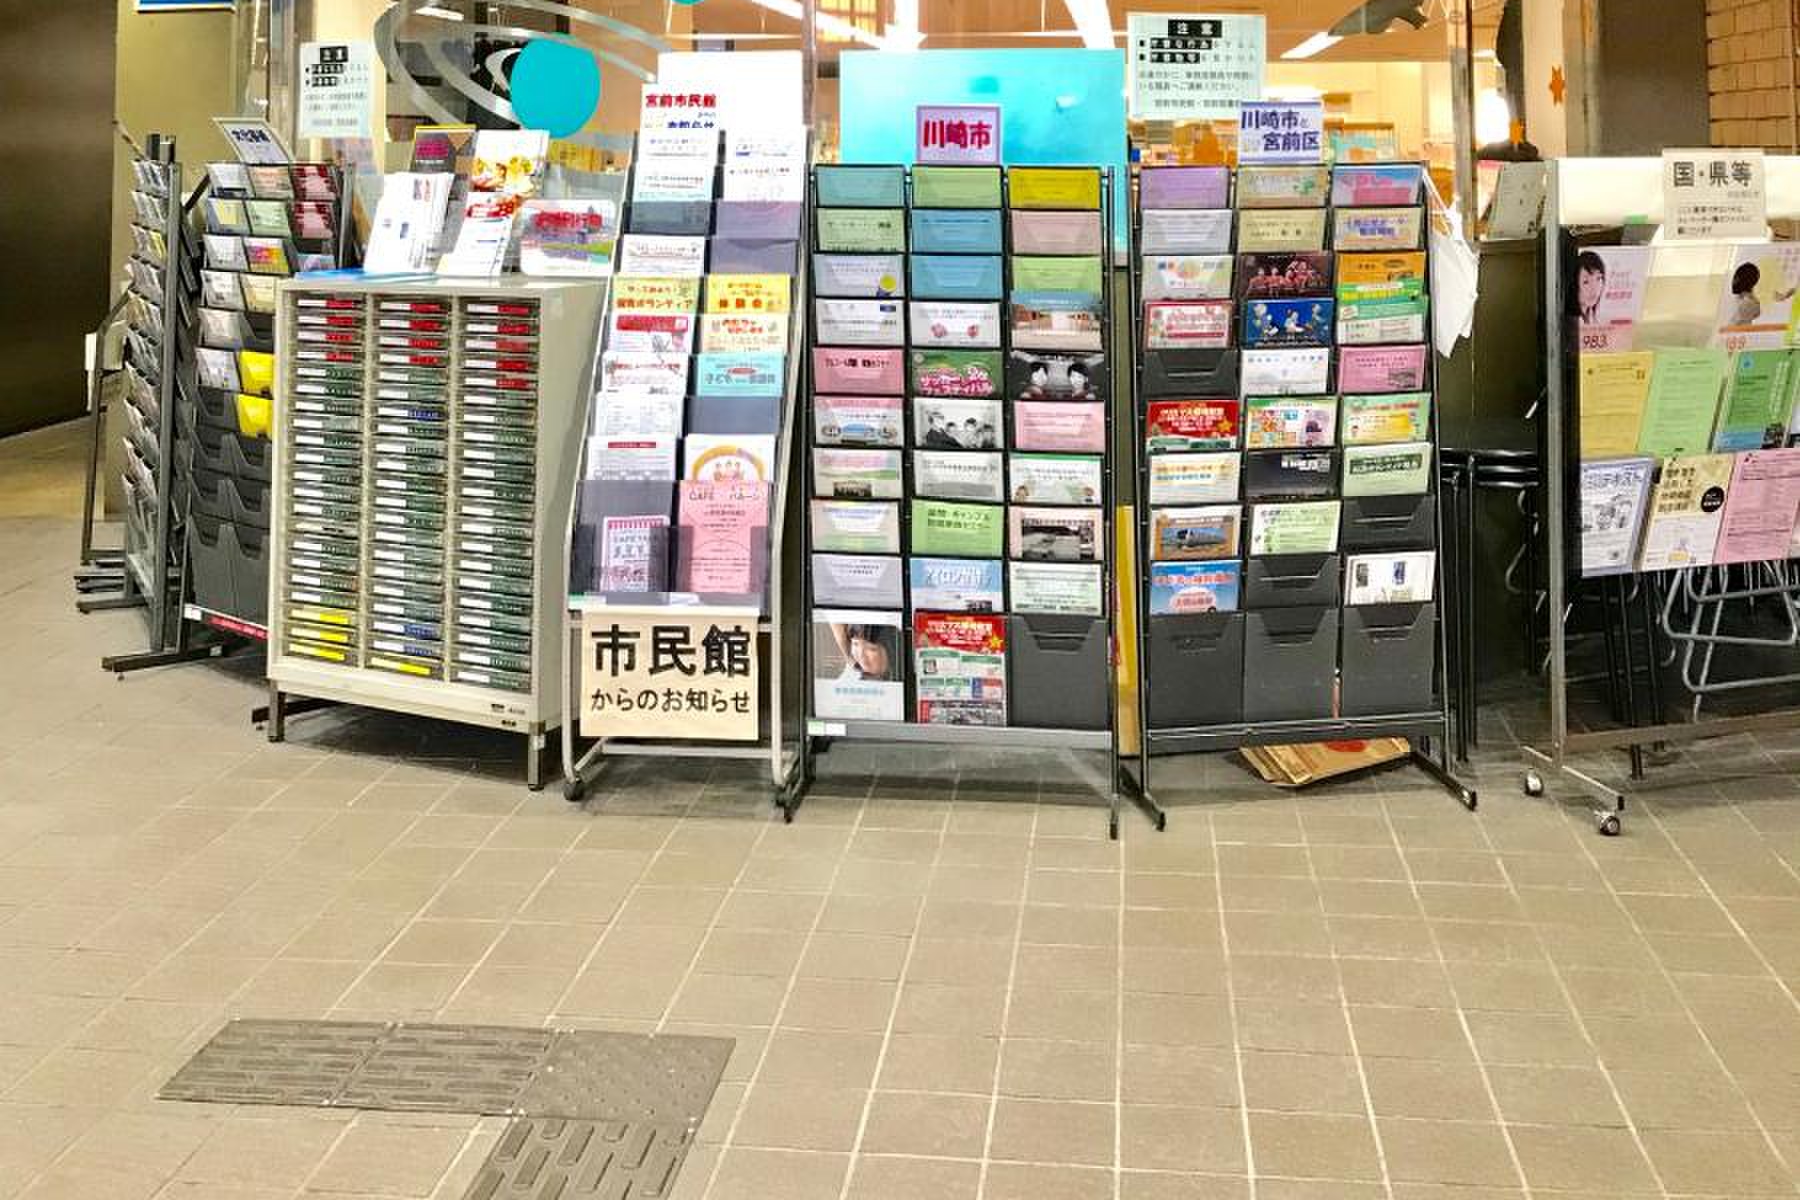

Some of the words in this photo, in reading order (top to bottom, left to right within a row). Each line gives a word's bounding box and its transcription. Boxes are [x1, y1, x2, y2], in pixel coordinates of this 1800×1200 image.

[922, 120, 992, 149] 川崎市
[1262, 131, 1320, 151] 宮前区
[1673, 160, 1752, 187] 国・県等
[591, 624, 750, 678] 市民館
[591, 688, 750, 714] からのお知らせ
